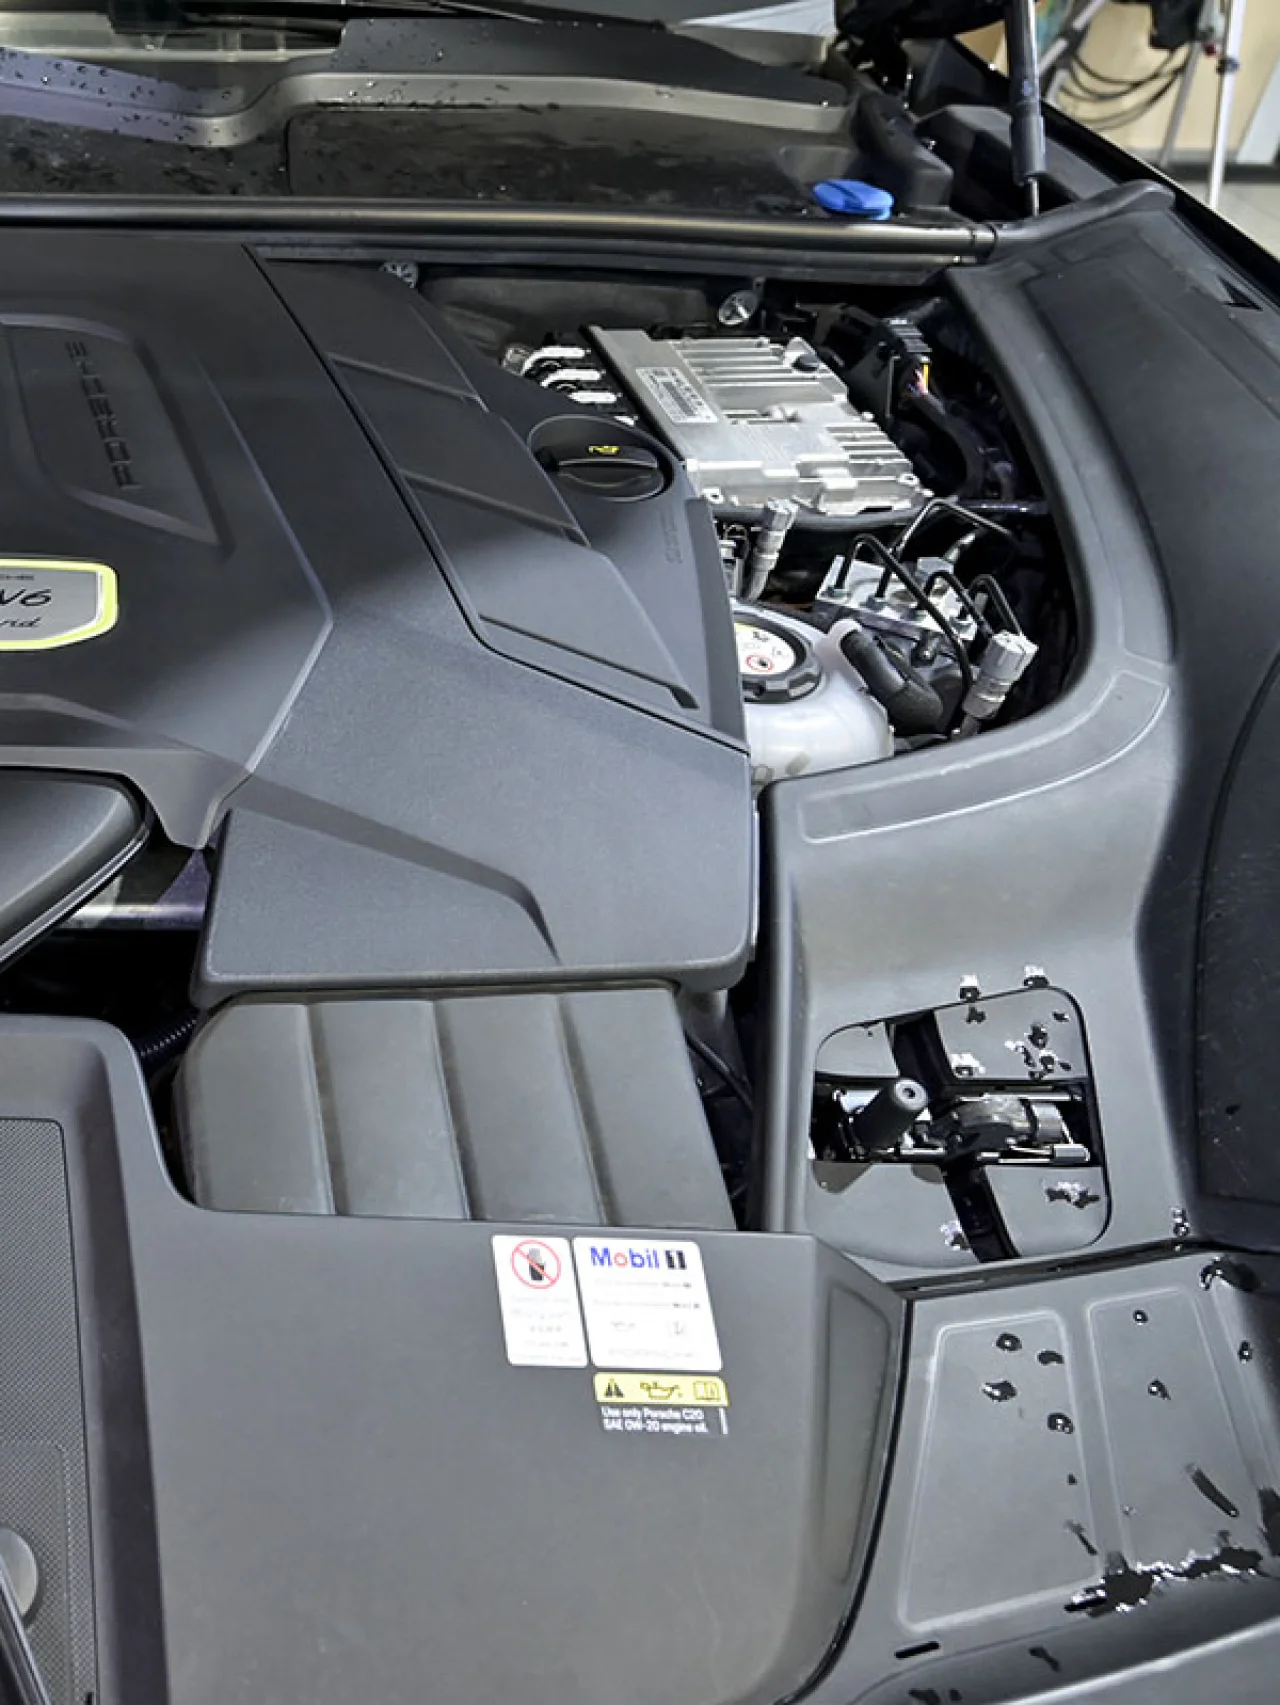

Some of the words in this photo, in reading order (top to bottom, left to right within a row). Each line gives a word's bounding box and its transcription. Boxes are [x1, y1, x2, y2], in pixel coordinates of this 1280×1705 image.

[590, 1246, 660, 1269] Mobil
[665, 1249, 687, 1269] 1
[601, 1406, 619, 1418] Use
[622, 1407, 641, 1420] only
[643, 1406, 682, 1420] Porsche
[661, 1421, 692, 1435] engine
